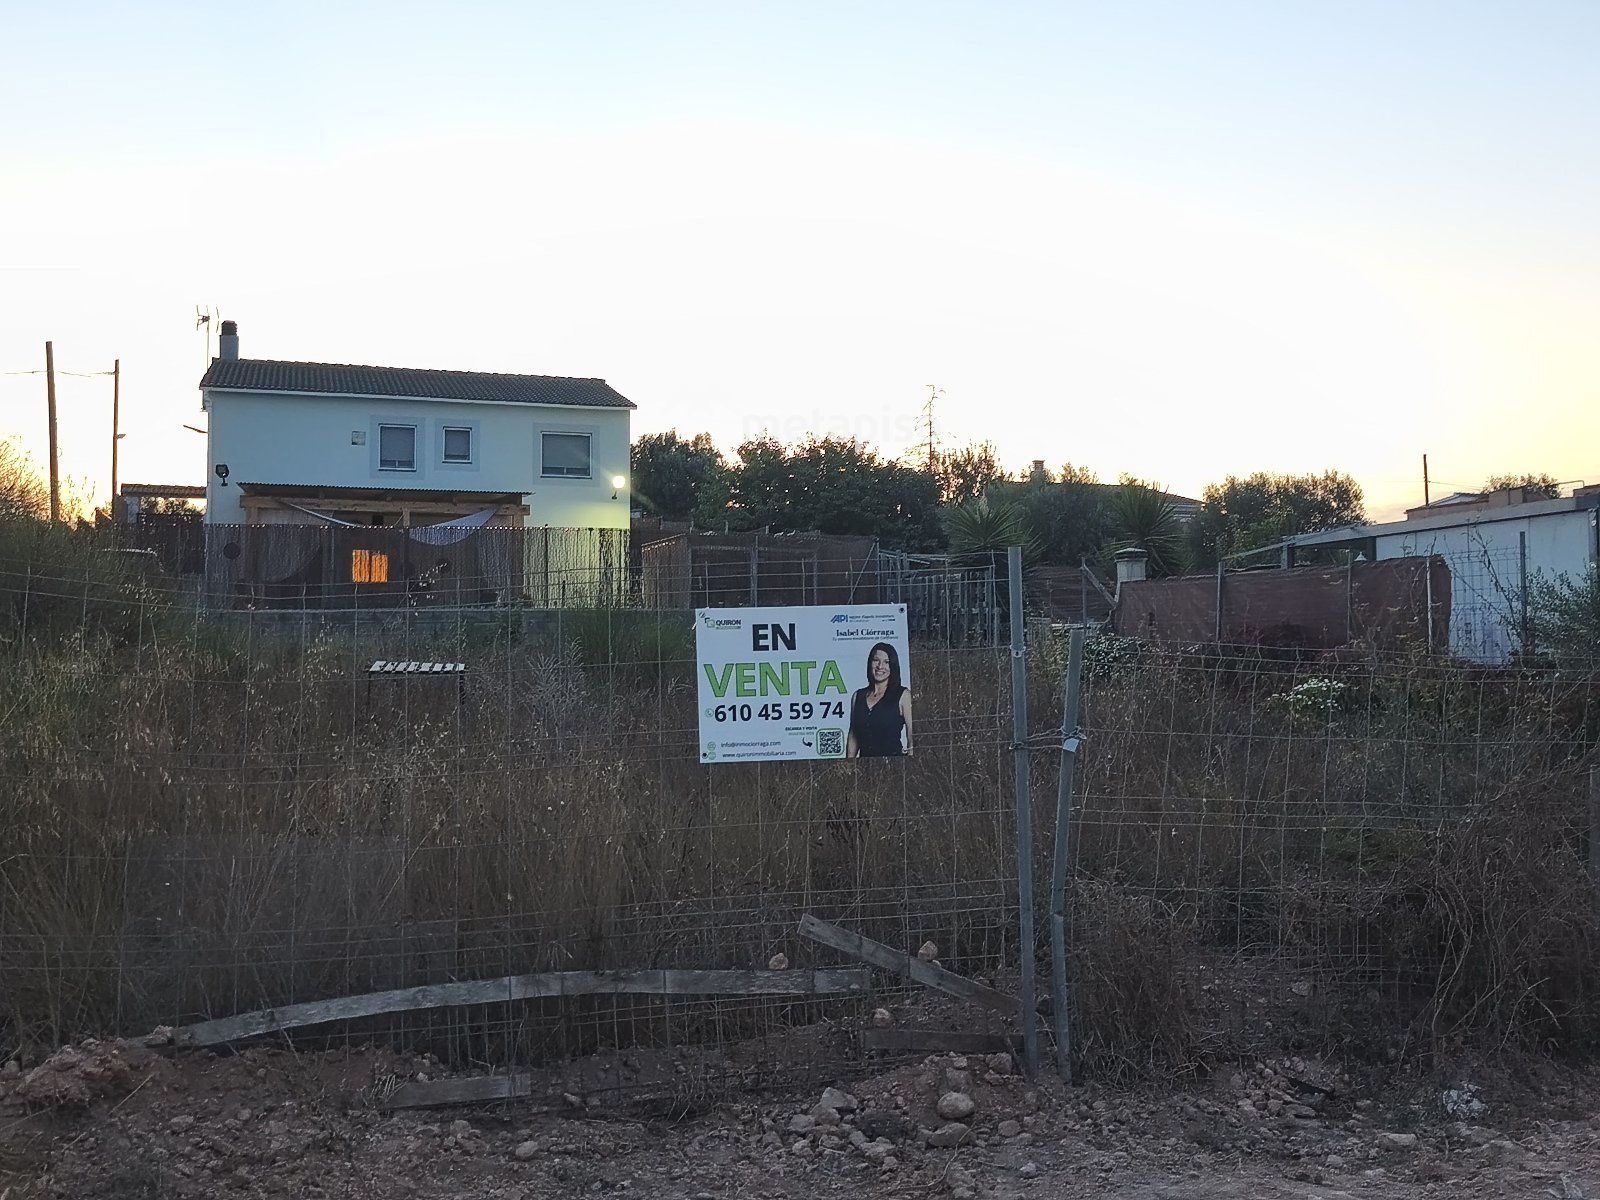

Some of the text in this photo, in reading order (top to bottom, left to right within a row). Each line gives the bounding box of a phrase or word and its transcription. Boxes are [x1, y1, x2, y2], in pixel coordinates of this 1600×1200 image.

[715, 619, 742, 627] QUIRON
[836, 629, 858, 637] Isabel
[752, 623, 797, 651] EN
[703, 660, 847, 697] VENTA
[714, 701, 845, 722] 610 45 59 74
